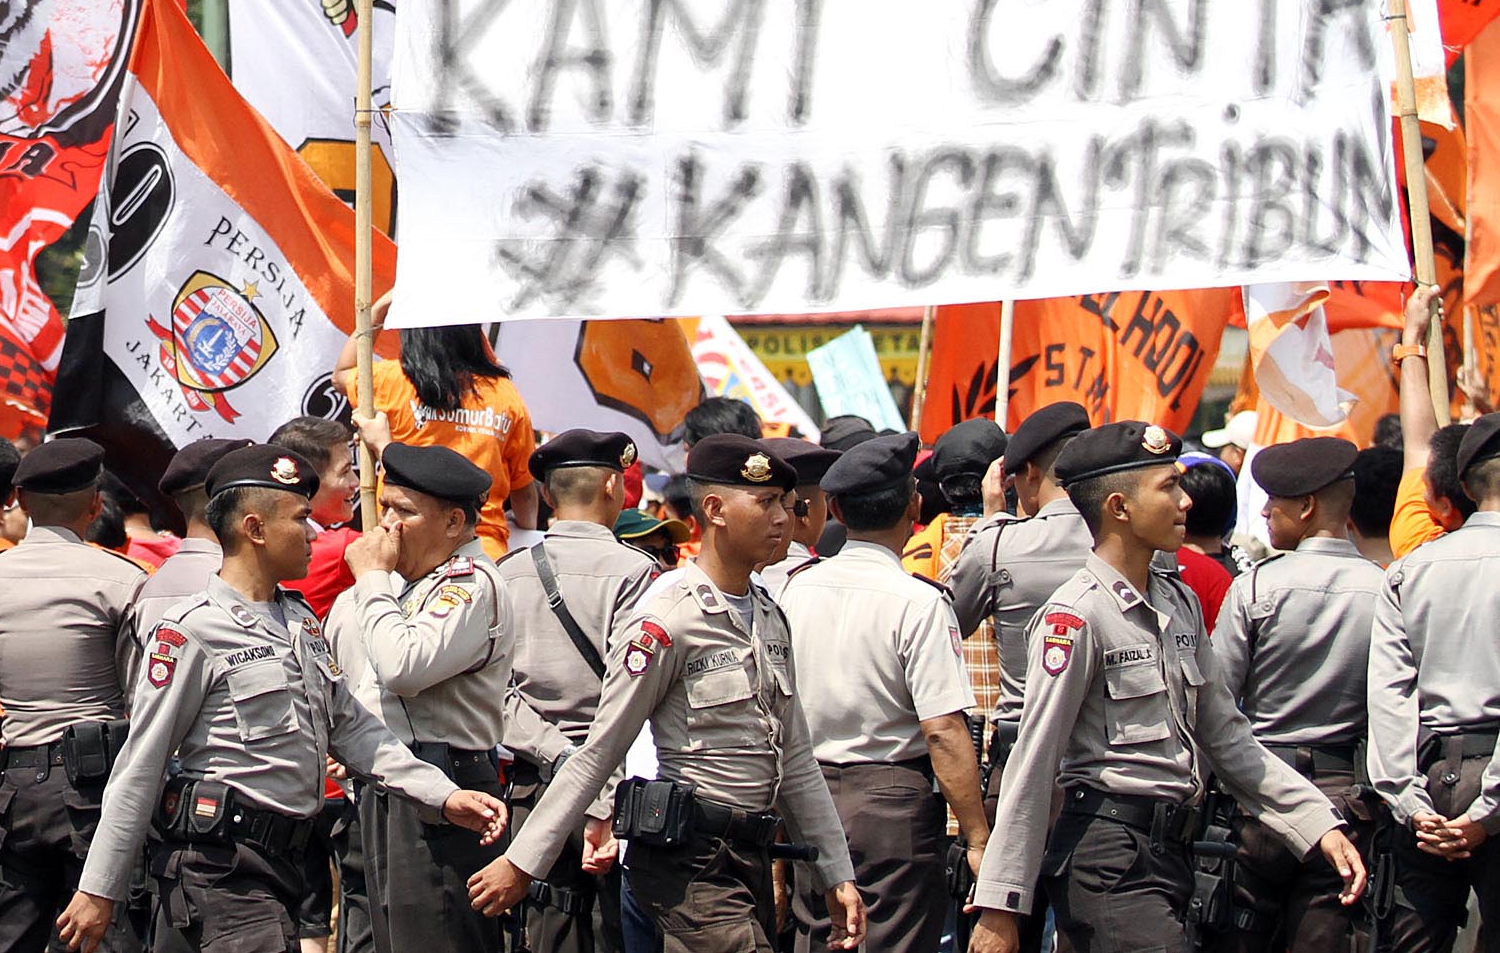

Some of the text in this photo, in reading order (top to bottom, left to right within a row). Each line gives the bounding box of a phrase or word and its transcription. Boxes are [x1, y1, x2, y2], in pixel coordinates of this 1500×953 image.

[204, 215, 308, 341] PERSIJA
[217, 287, 258, 330] PERSIJA
[225, 645, 276, 667] WICAKSONO
